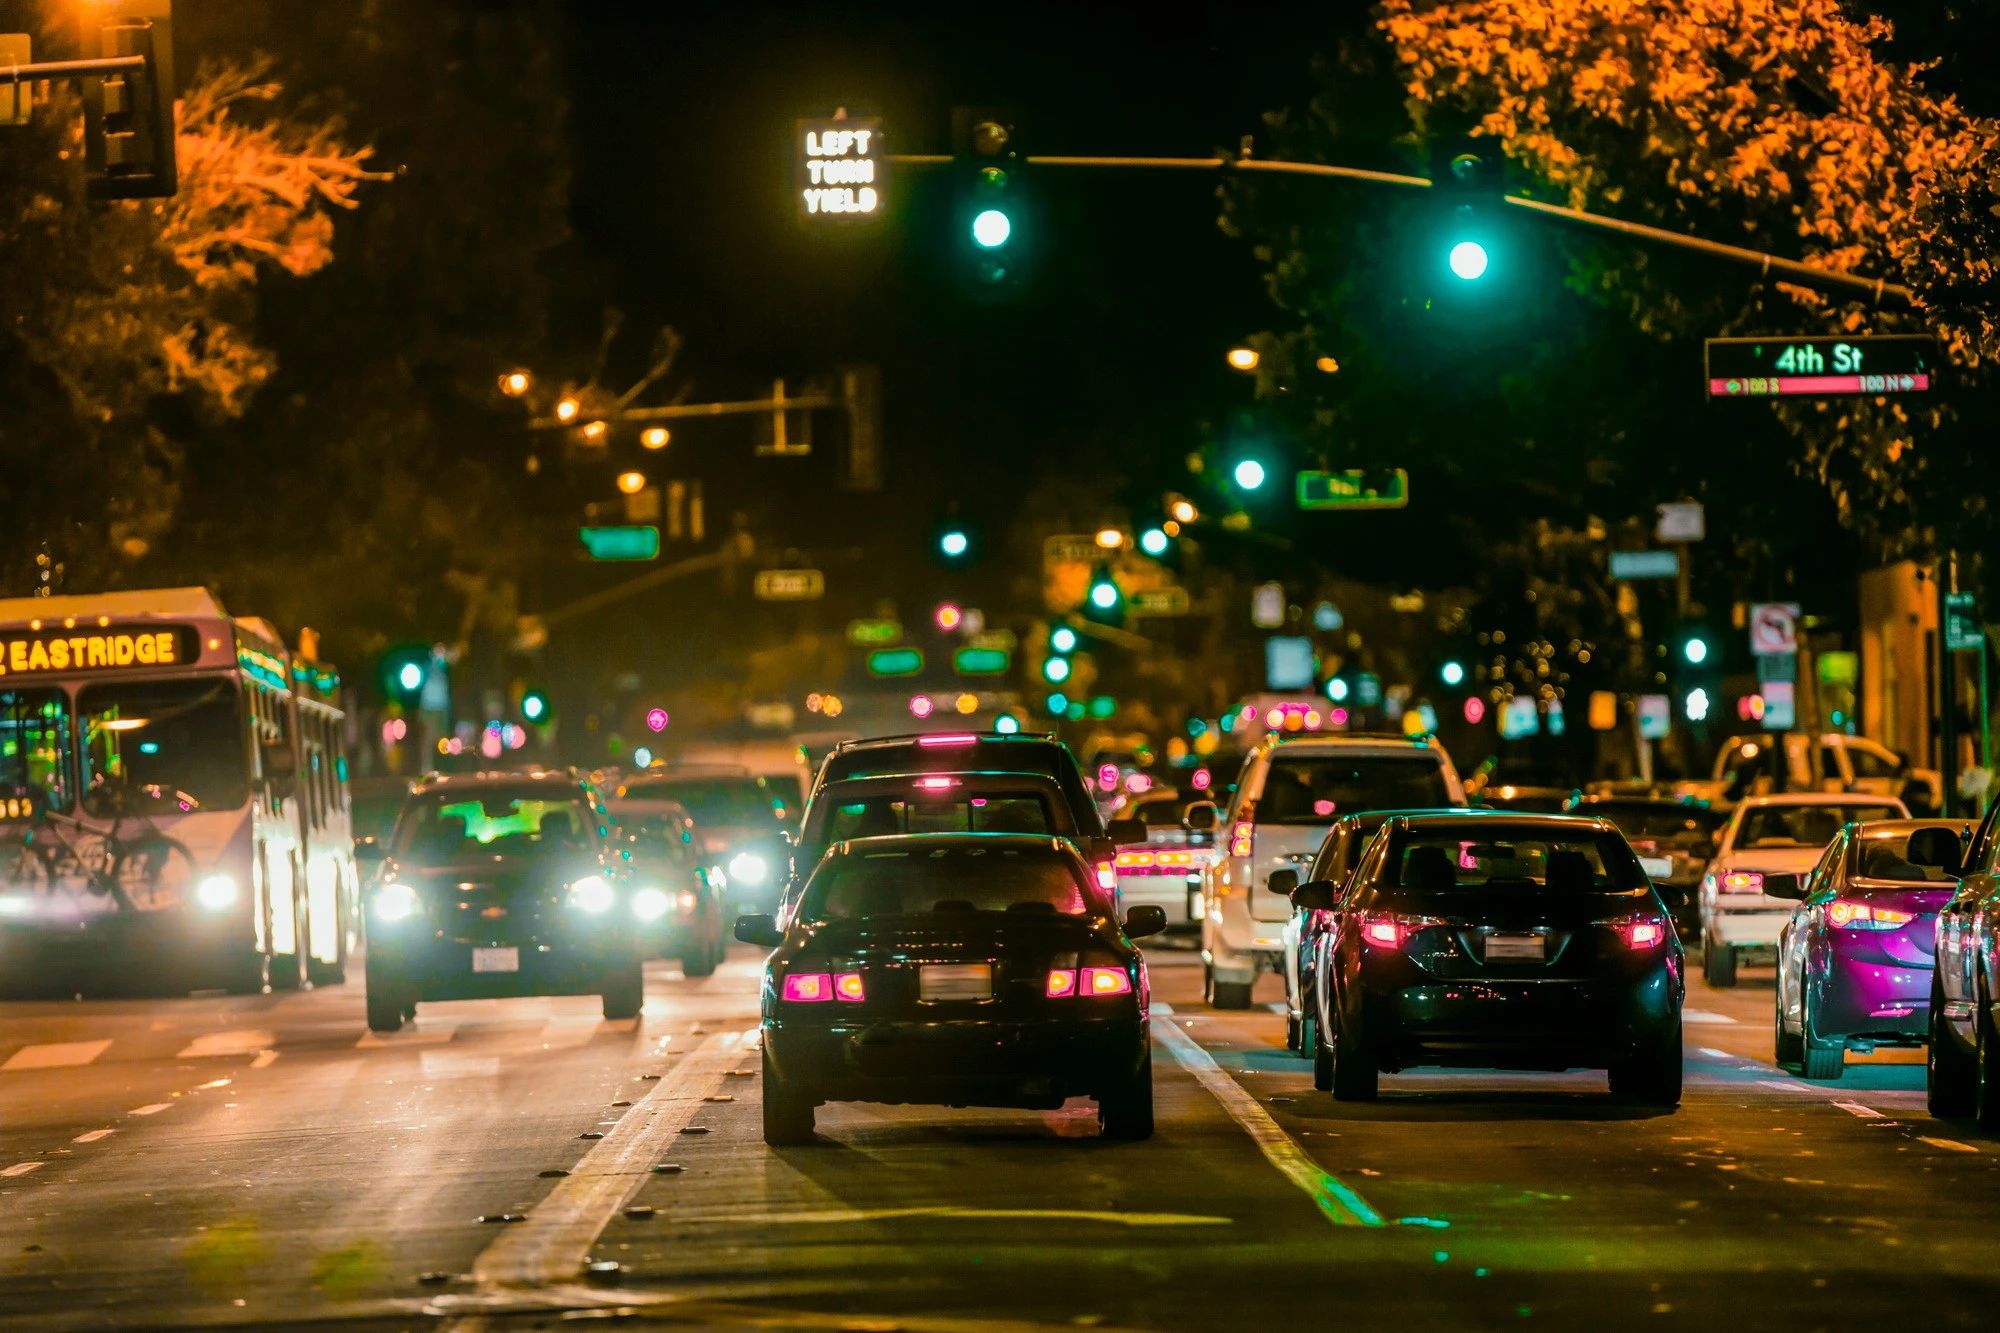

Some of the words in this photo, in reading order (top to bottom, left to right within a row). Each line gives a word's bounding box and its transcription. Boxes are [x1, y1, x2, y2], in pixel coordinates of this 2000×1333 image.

[807, 130, 872, 155] LEFT
[806, 158, 874, 184] TURN
[803, 187, 877, 213] YIELD
[1775, 344, 1824, 374] 4th
[1832, 343, 1863, 373] St
[1859, 375, 1886, 393] 100
[1886, 374, 1899, 393] N
[9, 632, 175, 671] EASTRIDGE
